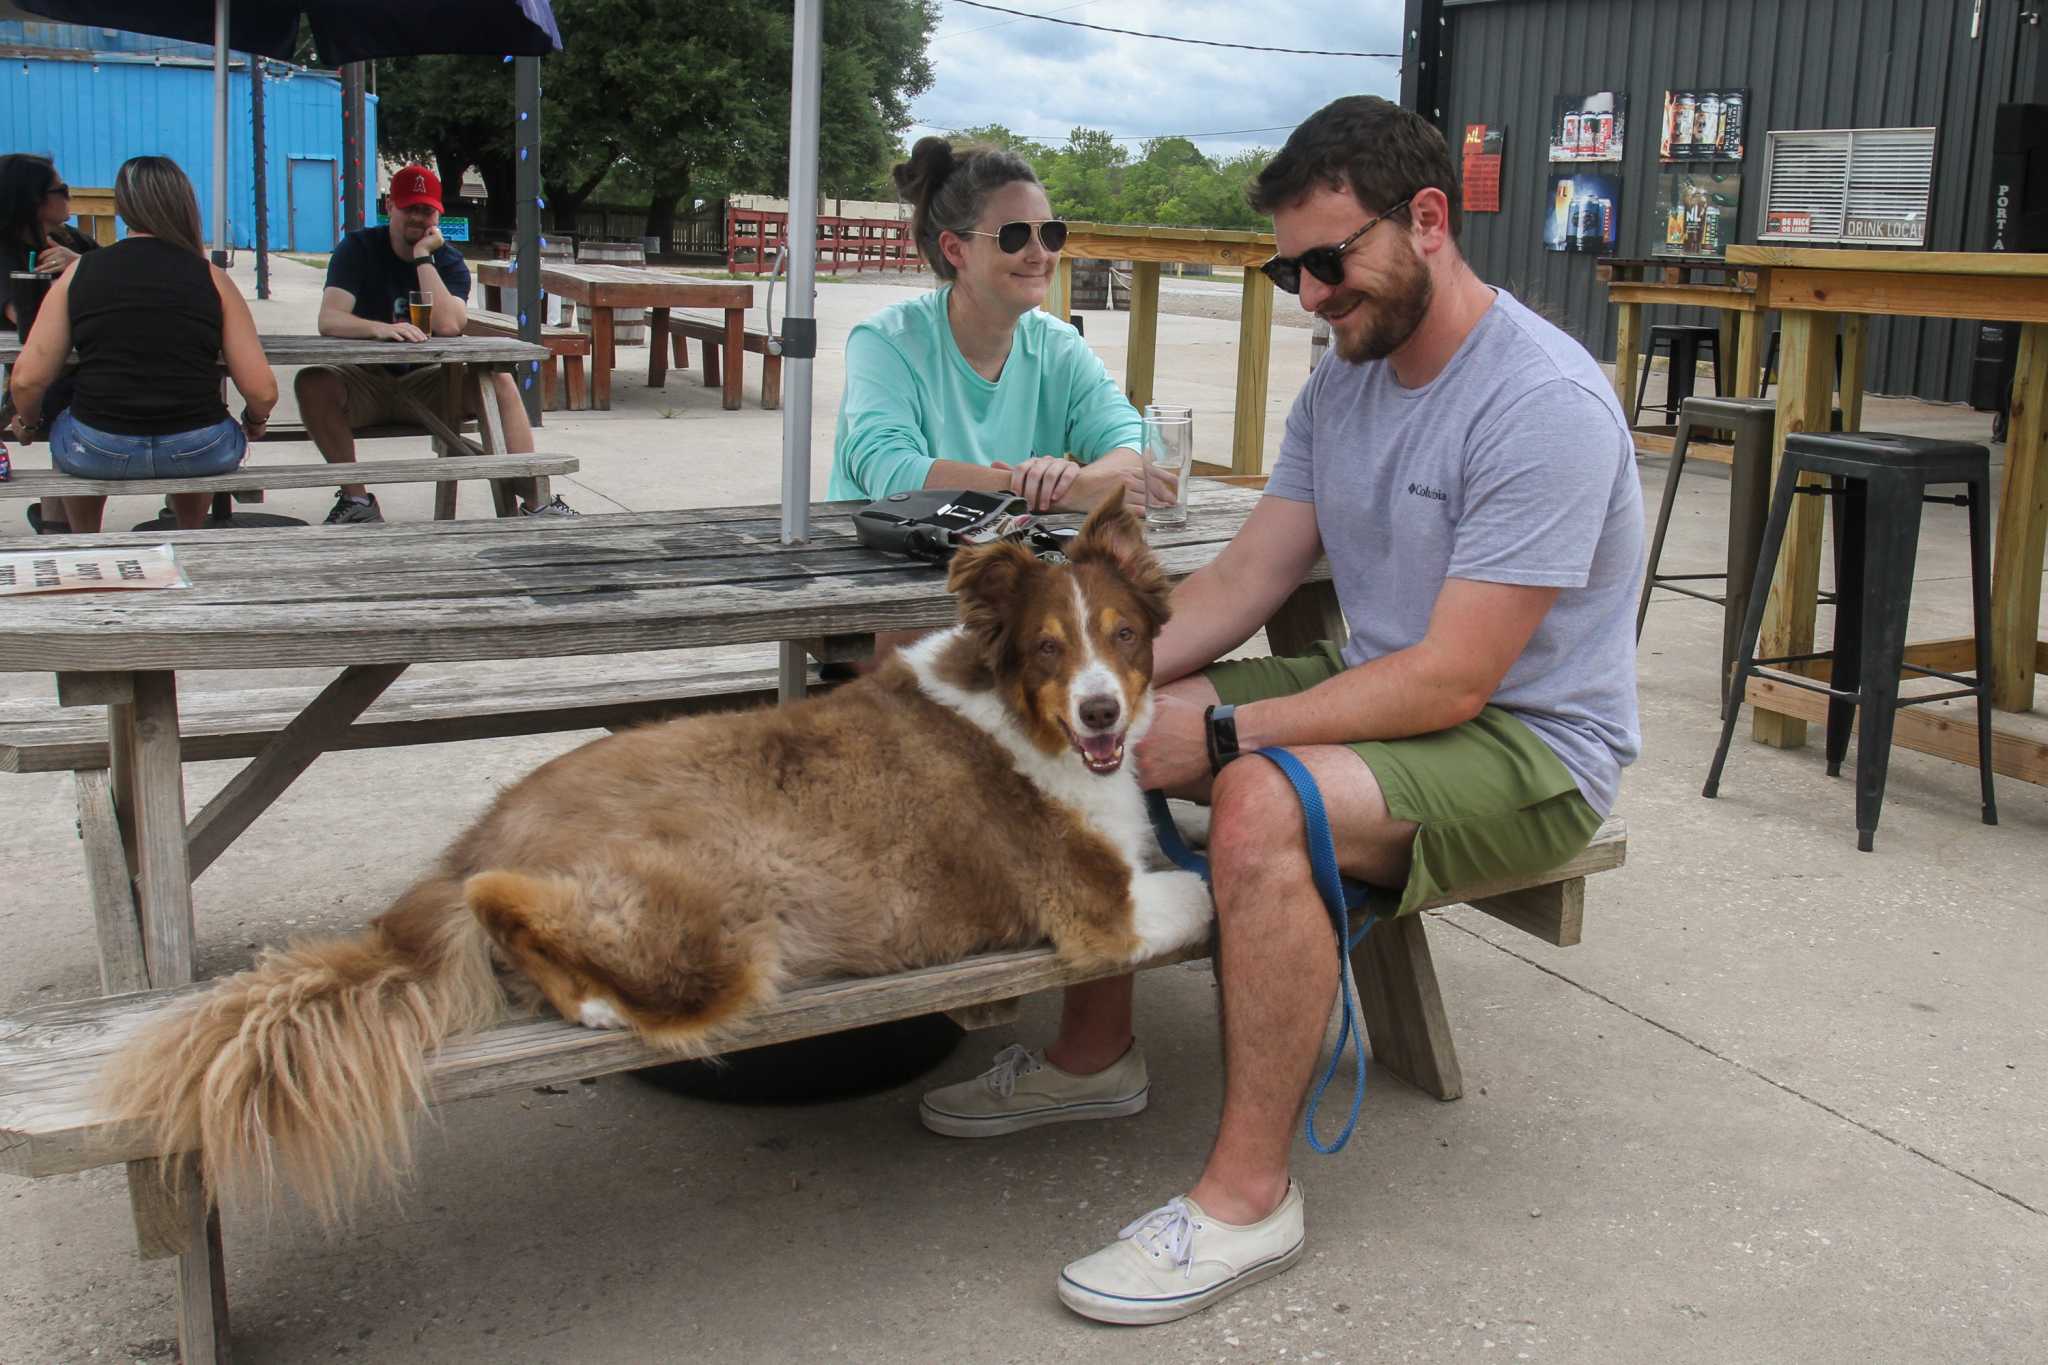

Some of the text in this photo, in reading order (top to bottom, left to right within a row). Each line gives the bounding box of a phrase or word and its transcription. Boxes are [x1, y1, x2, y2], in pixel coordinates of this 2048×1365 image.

[1466, 127, 1481, 144] NL
[413, 175, 426, 193] A
[1686, 204, 1701, 222] NL
[1847, 220, 1925, 239] DRINK LOCAL
[1415, 484, 1447, 501] Colubia
